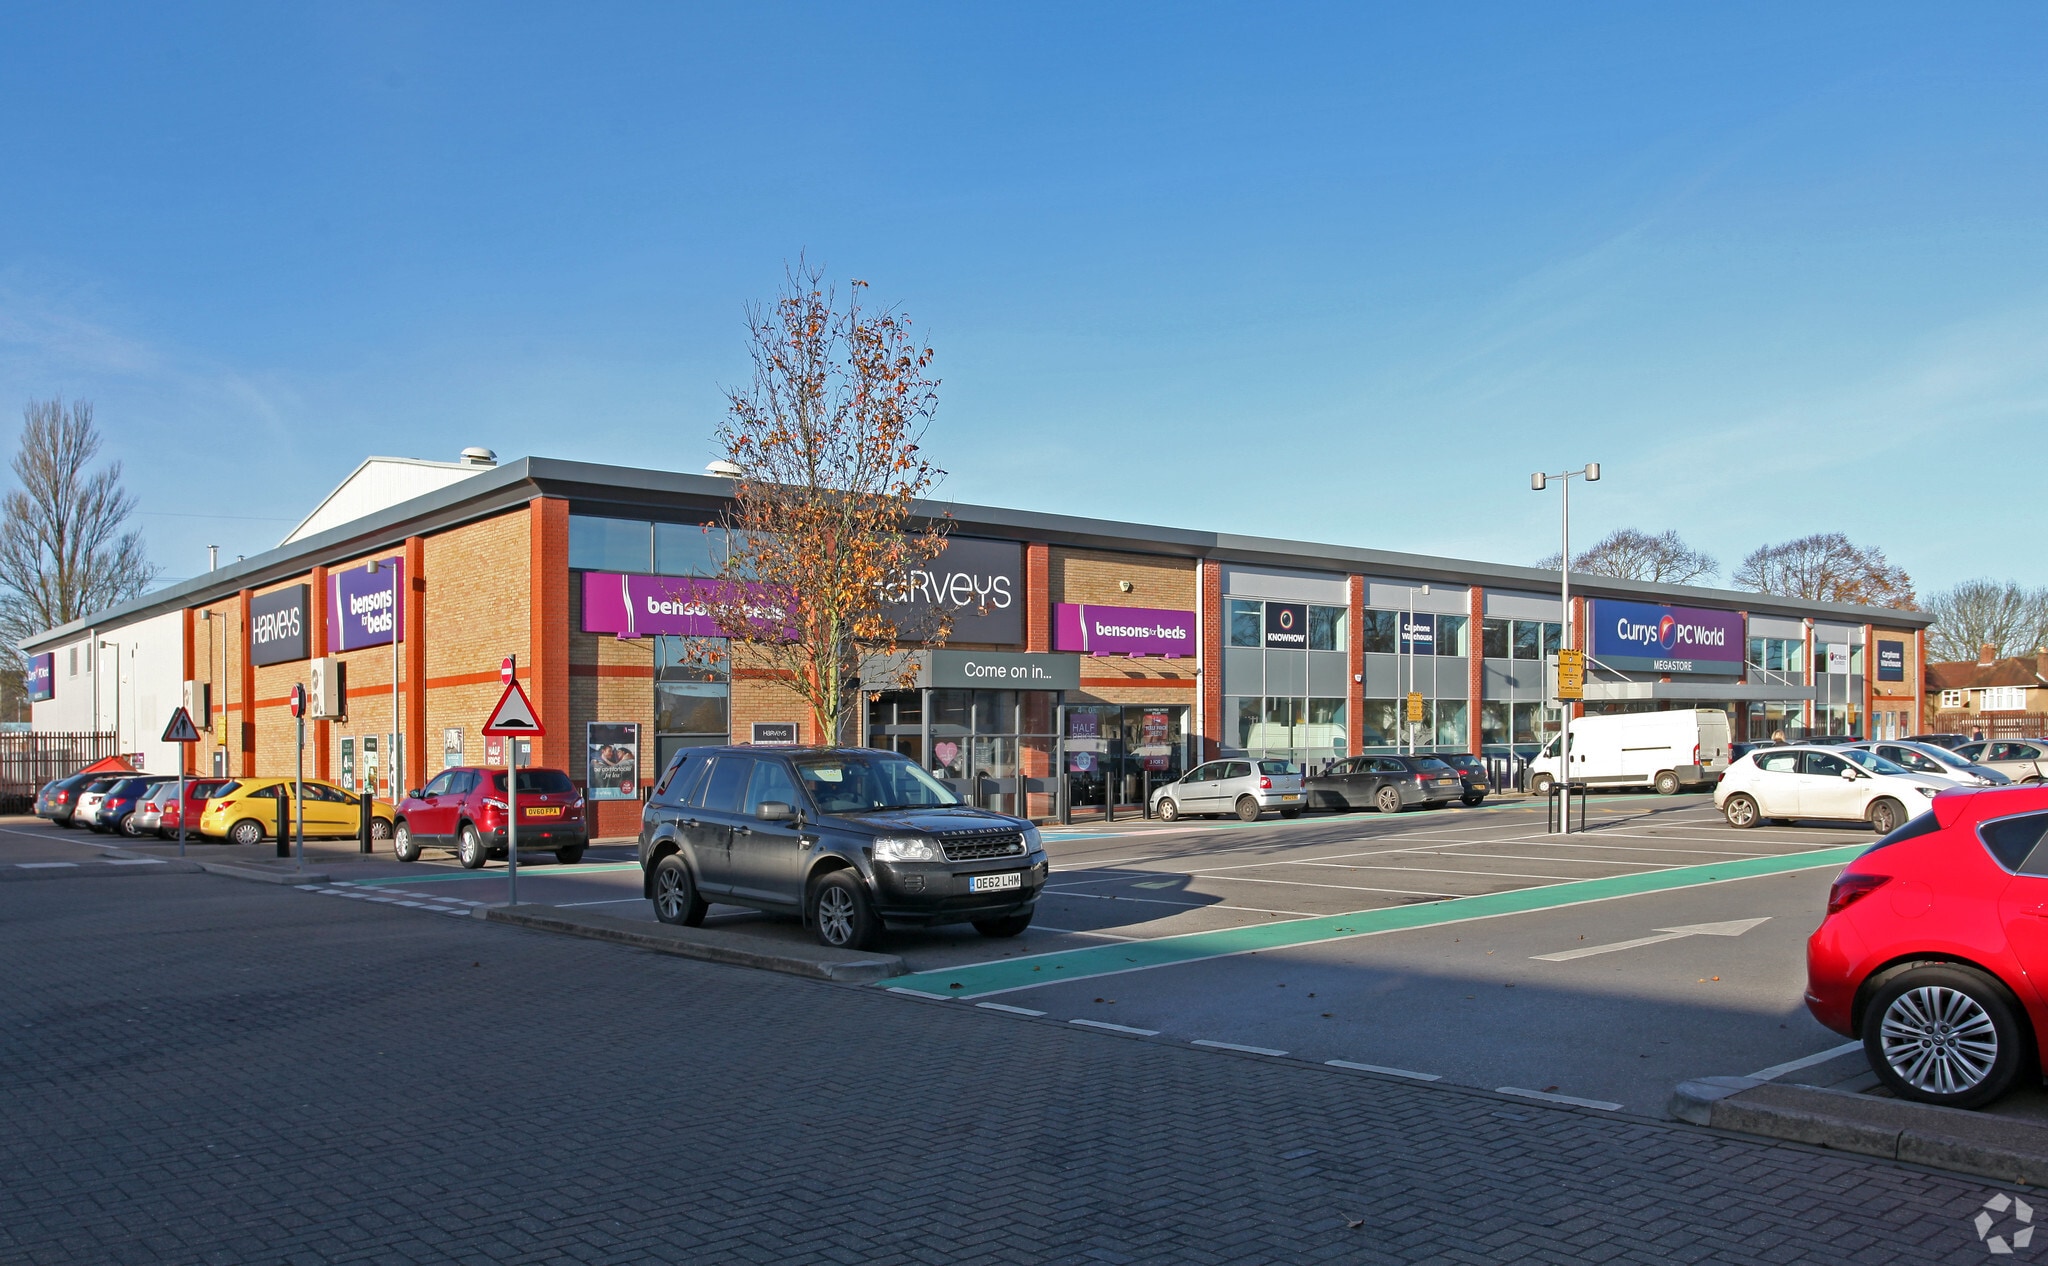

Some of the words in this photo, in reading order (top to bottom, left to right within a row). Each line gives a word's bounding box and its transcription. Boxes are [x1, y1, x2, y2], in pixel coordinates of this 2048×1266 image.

[350, 589, 393, 616] bensons
[361, 614, 369, 627] for
[367, 608, 393, 634] beds
[1095, 621, 1150, 638] bensons
[1149, 628, 1157, 637] for
[1156, 624, 1187, 640] beds
[1617, 617, 1658, 646] Currys
[1677, 623, 1694, 644] PC
[1694, 625, 1725, 646] World
[1267, 632, 1305, 643] KNOWHOW
[964, 661, 1007, 679] Come
[1010, 666, 1028, 679] on
[1031, 664, 1052, 679] in...
[1653, 660, 1692, 671] MEGASTORE
[1072, 723, 1095, 732] HALF
[487, 745, 501, 756] HALF
[487, 756, 501, 765] PRICE
[978, 826, 1014, 834] ROVER
[976, 876, 1001, 889] OE62
[1002, 874, 1020, 887] LHM
